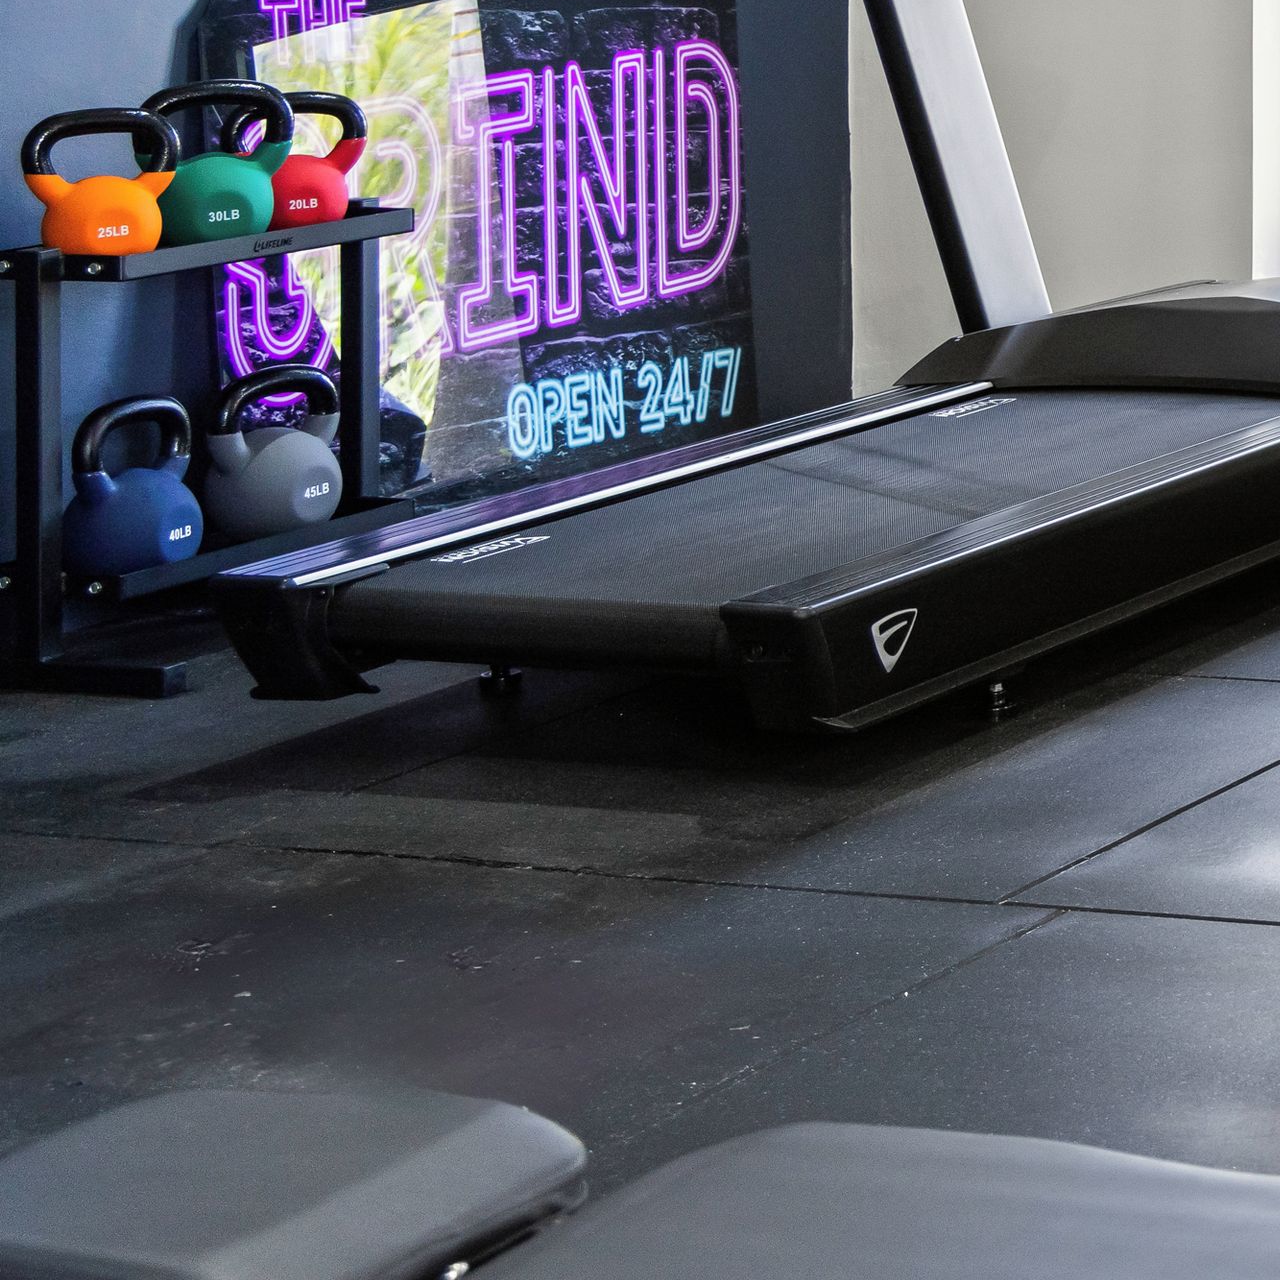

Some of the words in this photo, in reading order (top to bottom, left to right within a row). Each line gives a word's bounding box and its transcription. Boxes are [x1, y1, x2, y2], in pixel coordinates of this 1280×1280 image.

[288, 198, 318, 211] 20LB
[208, 209, 240, 223] 30LB
[97, 225, 129, 239] 25LB
[507, 368, 626, 460] OPEN
[636, 346, 743, 434] 24/7
[304, 482, 330, 499] 45LB
[168, 524, 192, 542] 40LB
